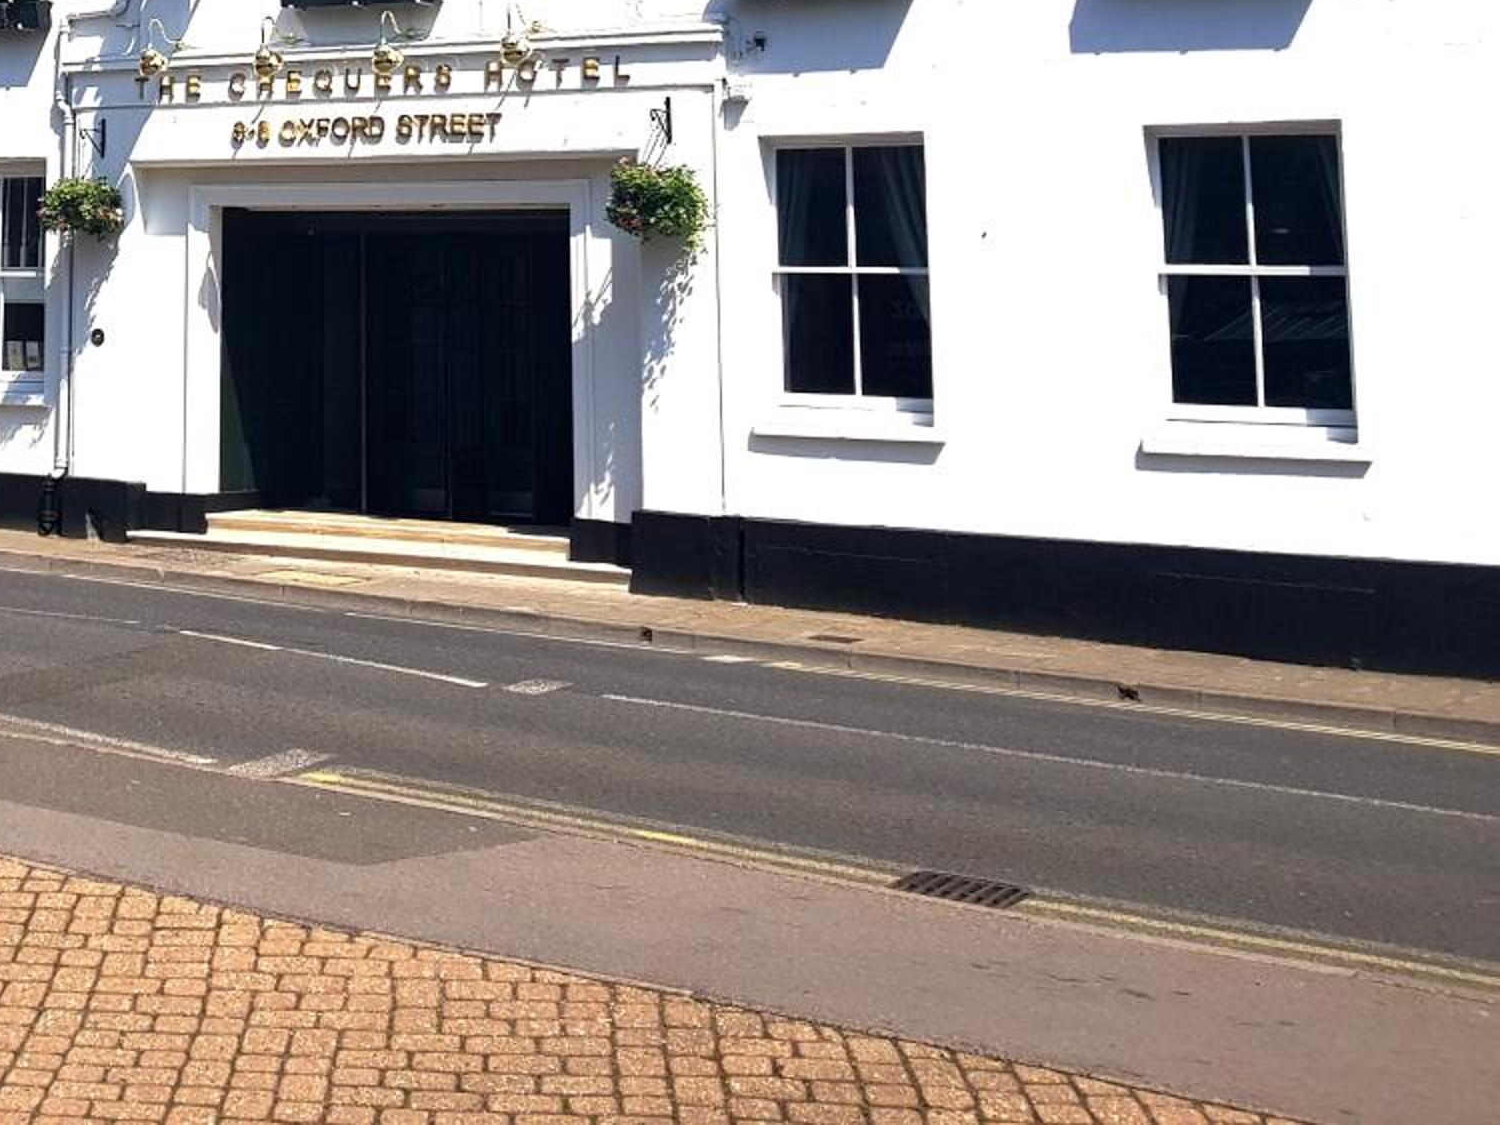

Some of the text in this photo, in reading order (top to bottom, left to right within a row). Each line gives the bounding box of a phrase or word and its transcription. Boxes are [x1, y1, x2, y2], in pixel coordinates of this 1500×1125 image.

[134, 55, 631, 101] THE CHEQUERS HOTEL
[280, 116, 385, 146] OXFORD
[396, 113, 502, 142] STREET
